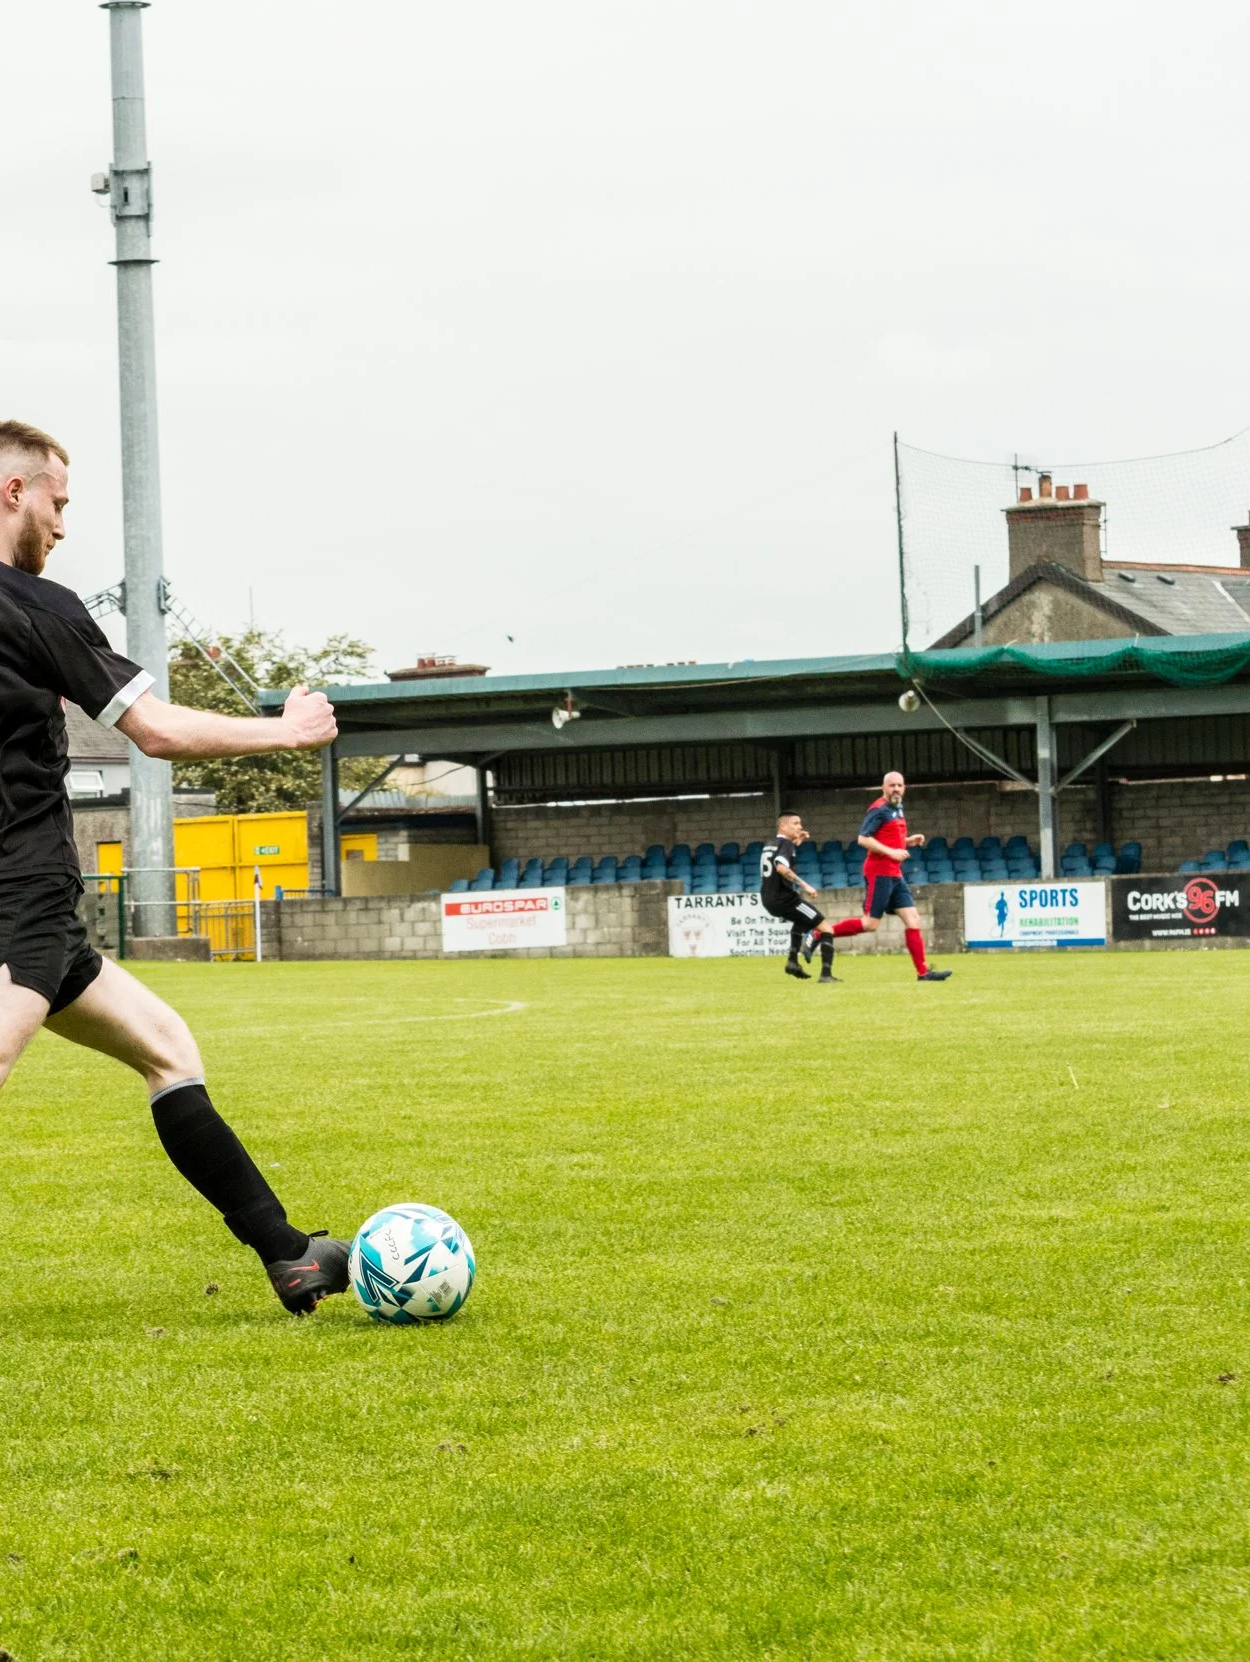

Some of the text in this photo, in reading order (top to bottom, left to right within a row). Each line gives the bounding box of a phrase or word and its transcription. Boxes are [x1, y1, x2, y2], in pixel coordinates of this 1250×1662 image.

[674, 893, 759, 909] TARRANT'S
[1018, 888, 1079, 909] SPORTS
[1127, 885, 1240, 914] CORK'S 96 FM
[460, 899, 548, 915] EUROSPAR
[466, 916, 537, 930] Supermarket
[730, 916, 742, 926] Be
[488, 932, 517, 945] Cobh
[749, 928, 764, 937] The
[753, 938, 764, 946] All
[768, 938, 787, 946] Your
